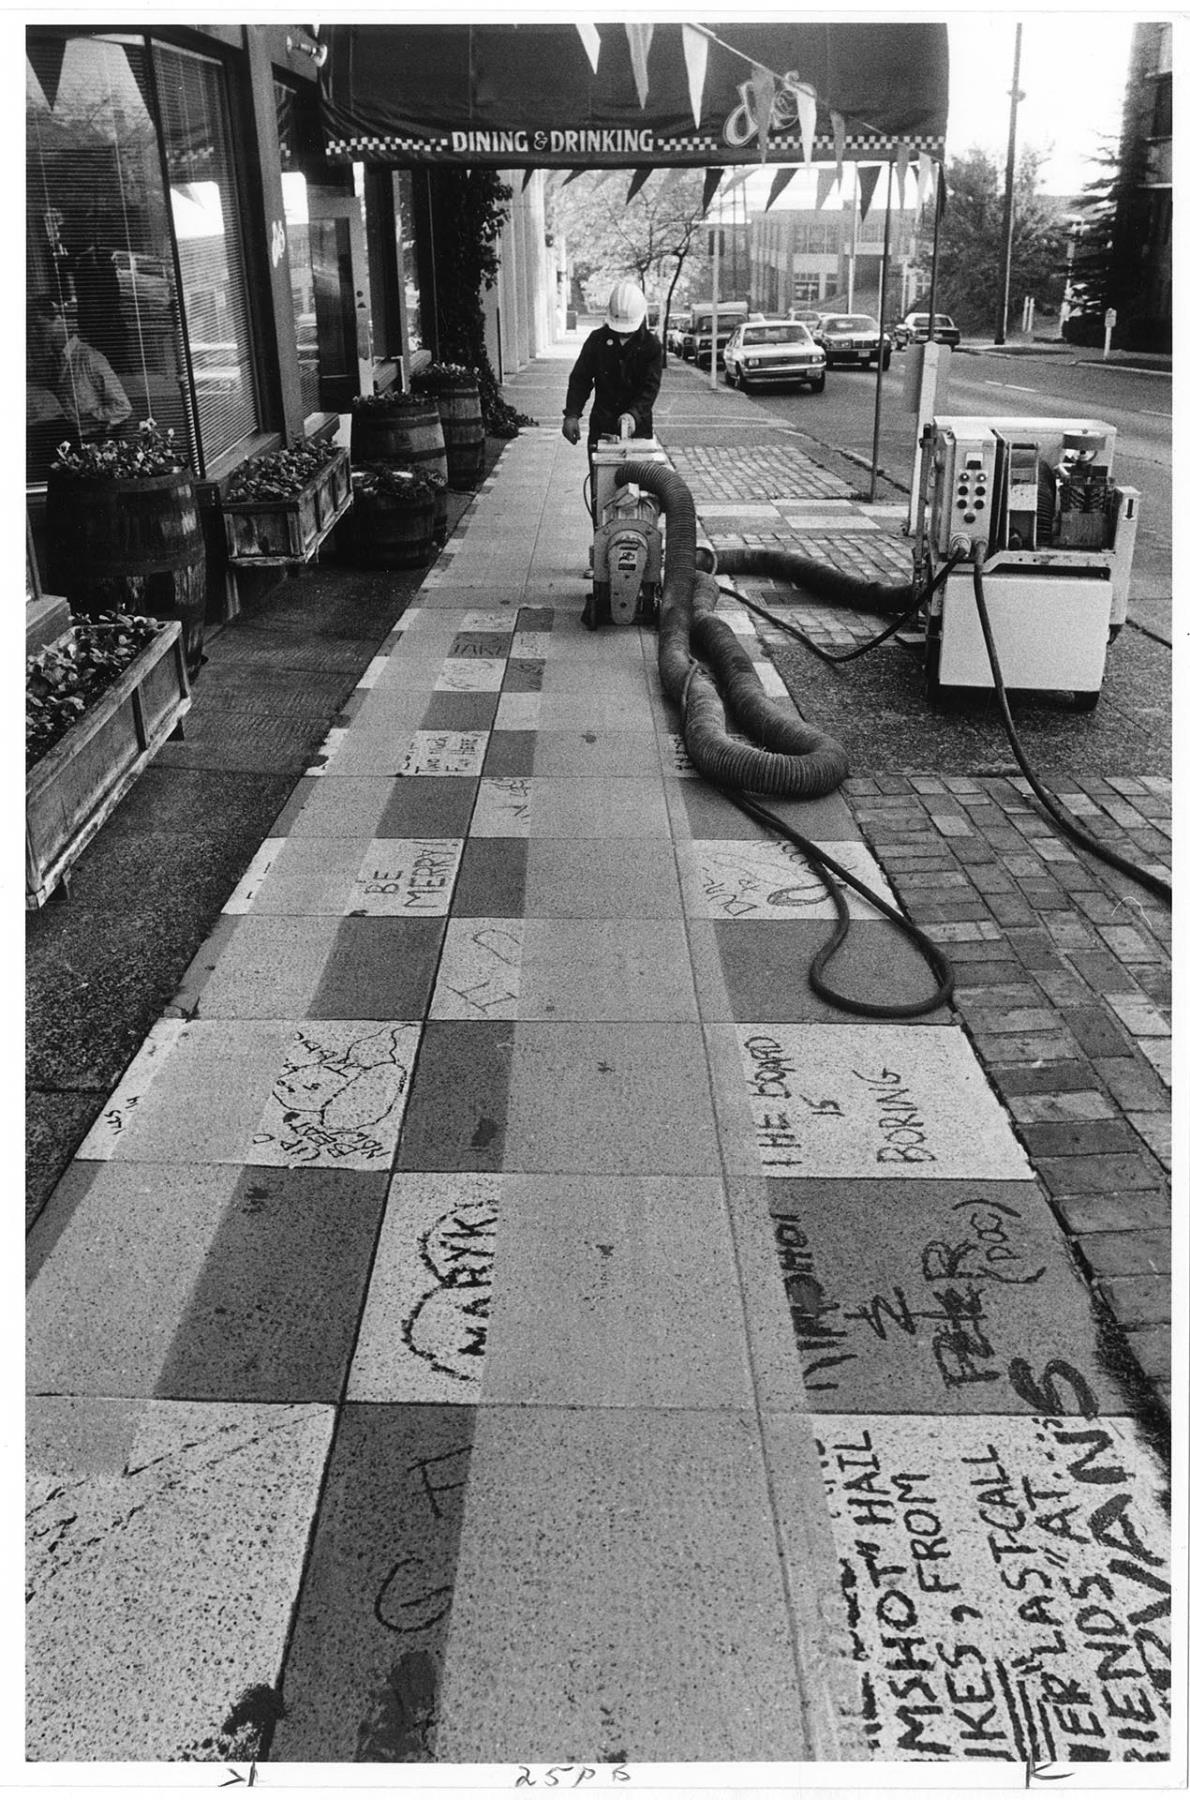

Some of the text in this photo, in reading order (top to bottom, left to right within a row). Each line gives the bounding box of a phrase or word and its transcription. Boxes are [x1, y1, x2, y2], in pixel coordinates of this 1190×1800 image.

[452, 129, 654, 152] DINING & DRINKING
[852, 1068, 936, 1162] BORING
[833, 1430, 894, 1525] HAIL
[891, 1474, 961, 1594] FROM
